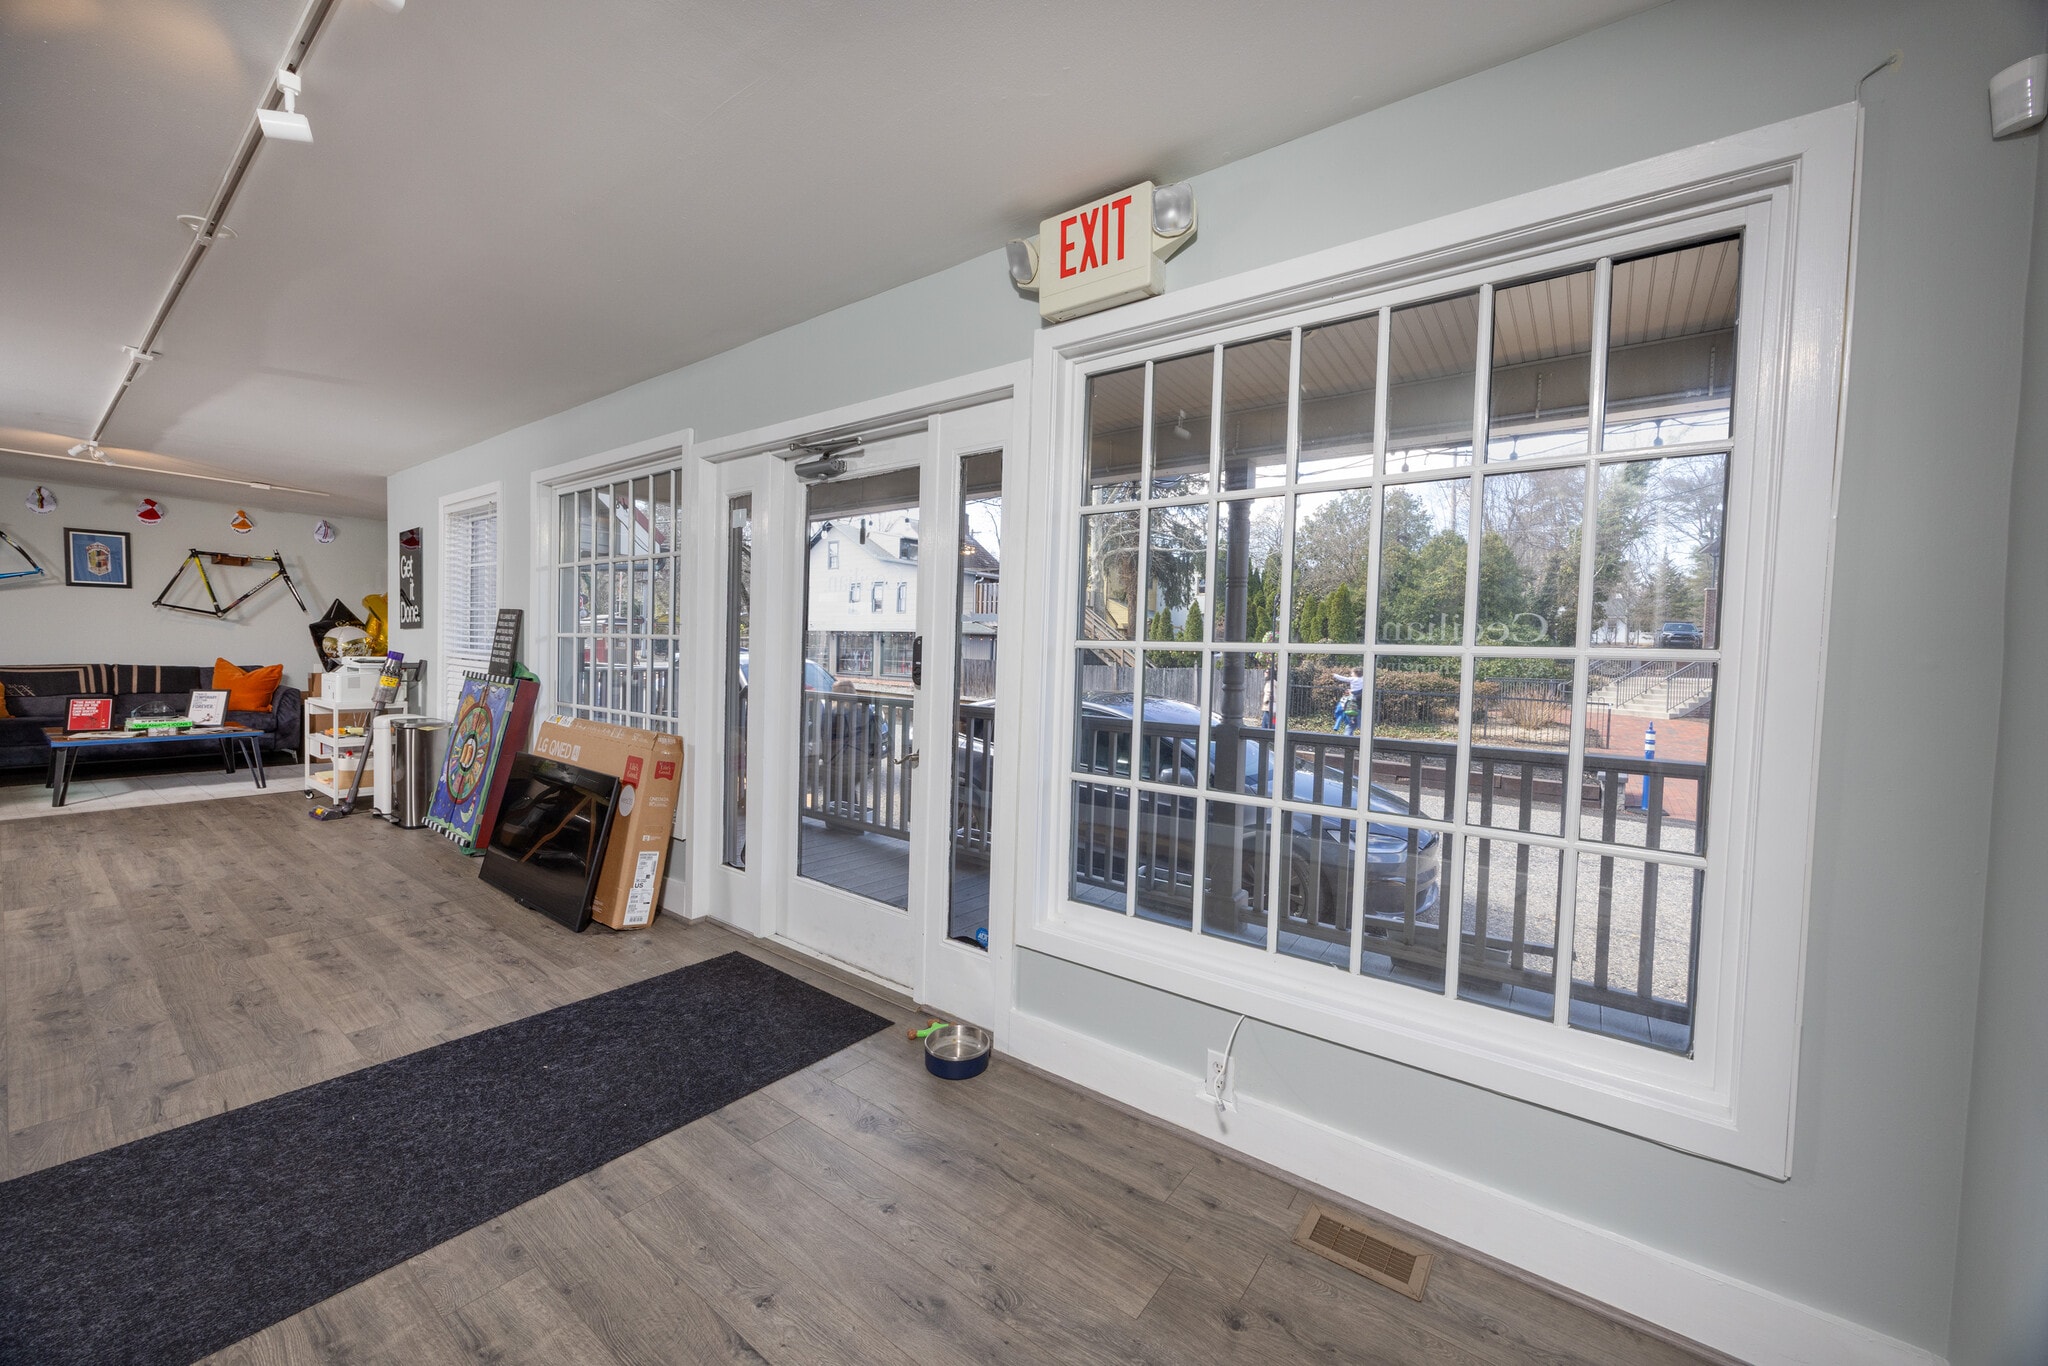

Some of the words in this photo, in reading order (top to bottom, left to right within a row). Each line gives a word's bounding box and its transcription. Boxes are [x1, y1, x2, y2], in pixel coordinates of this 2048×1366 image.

[1060, 195, 1132, 279] EXIT
[400, 555, 414, 579] Get
[409, 578, 415, 601] it
[400, 601, 421, 623] Done.
[537, 736, 549, 753] LG
[549, 739, 572, 759] QNED
